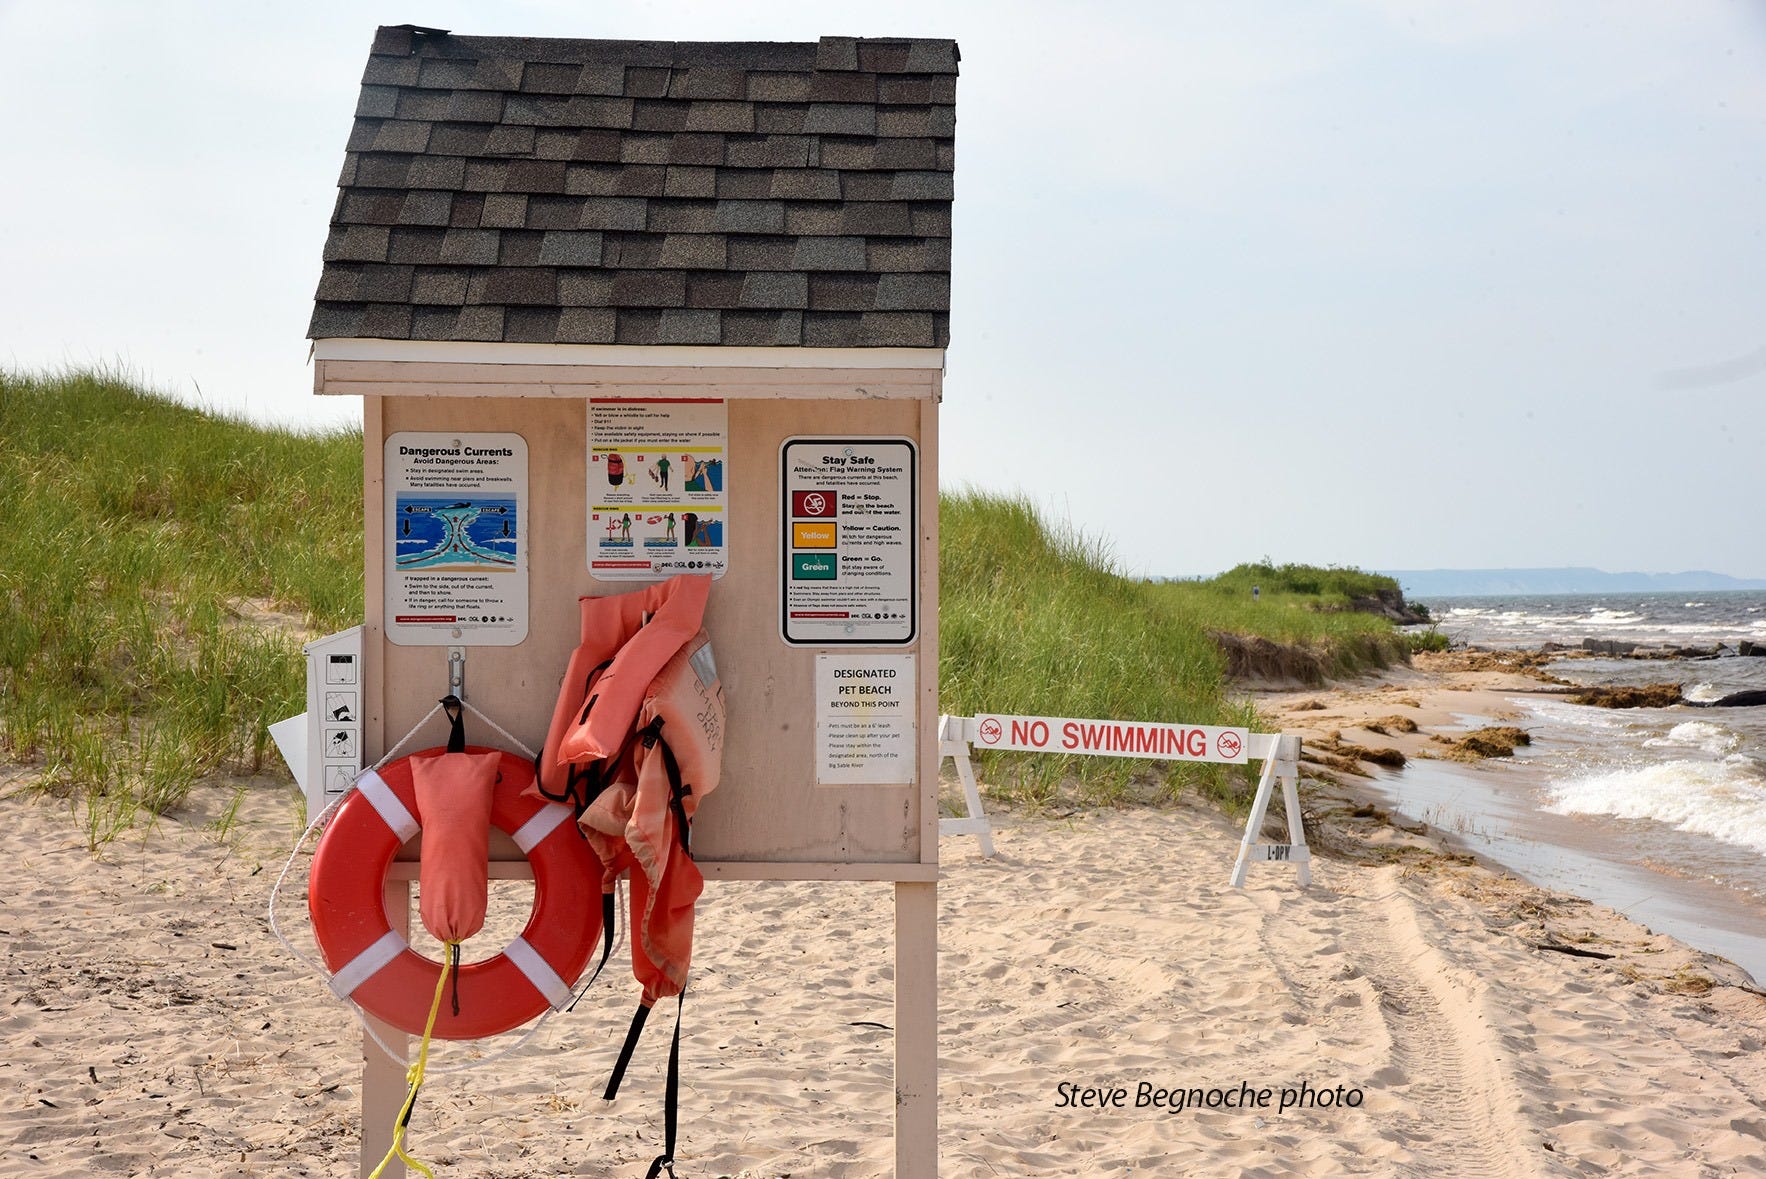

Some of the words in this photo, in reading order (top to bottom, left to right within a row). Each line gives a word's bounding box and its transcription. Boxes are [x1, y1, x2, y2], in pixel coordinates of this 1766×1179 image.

[400, 447, 460, 457] Dangerous
[464, 447, 512, 456] Currents
[822, 456, 847, 466] Stay
[834, 670, 896, 678] DESIGNATED
[839, 686, 856, 694] PET
[859, 686, 891, 694] BEACH
[1012, 720, 1049, 747] NO
[1062, 722, 1206, 757] SWIMMING
